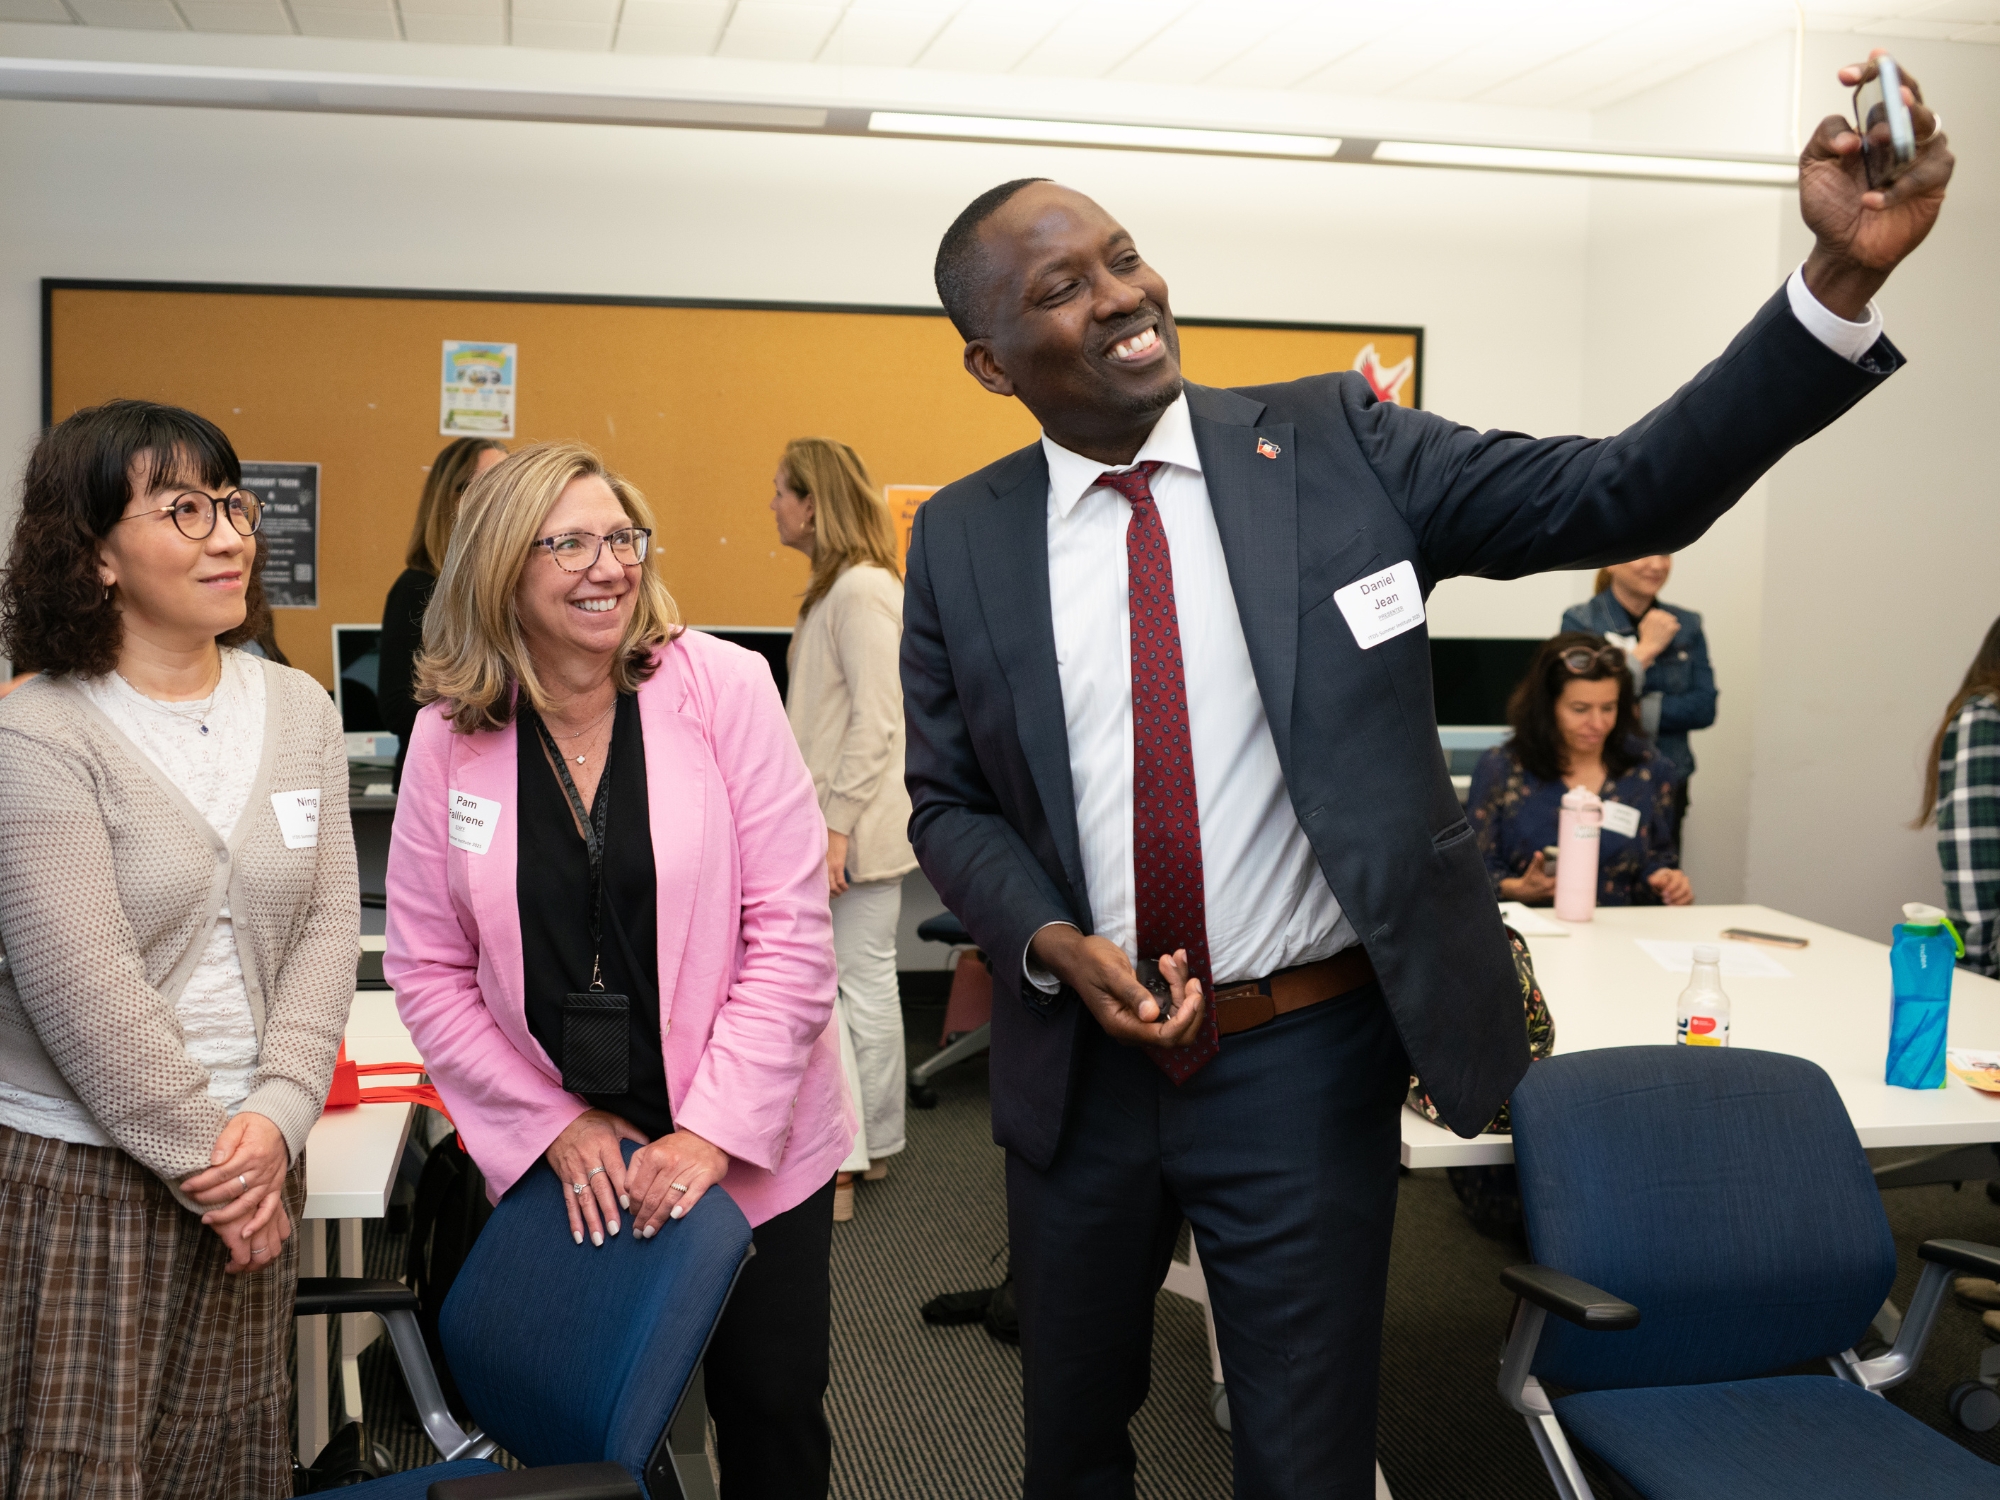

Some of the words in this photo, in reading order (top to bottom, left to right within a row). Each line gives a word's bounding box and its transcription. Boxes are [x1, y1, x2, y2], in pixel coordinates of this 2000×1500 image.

[1360, 573, 1395, 595] Daniel
[1374, 593, 1400, 610] Jean
[296, 797, 317, 808] Ning
[456, 795, 478, 809] Pam
[305, 813, 316, 822] He
